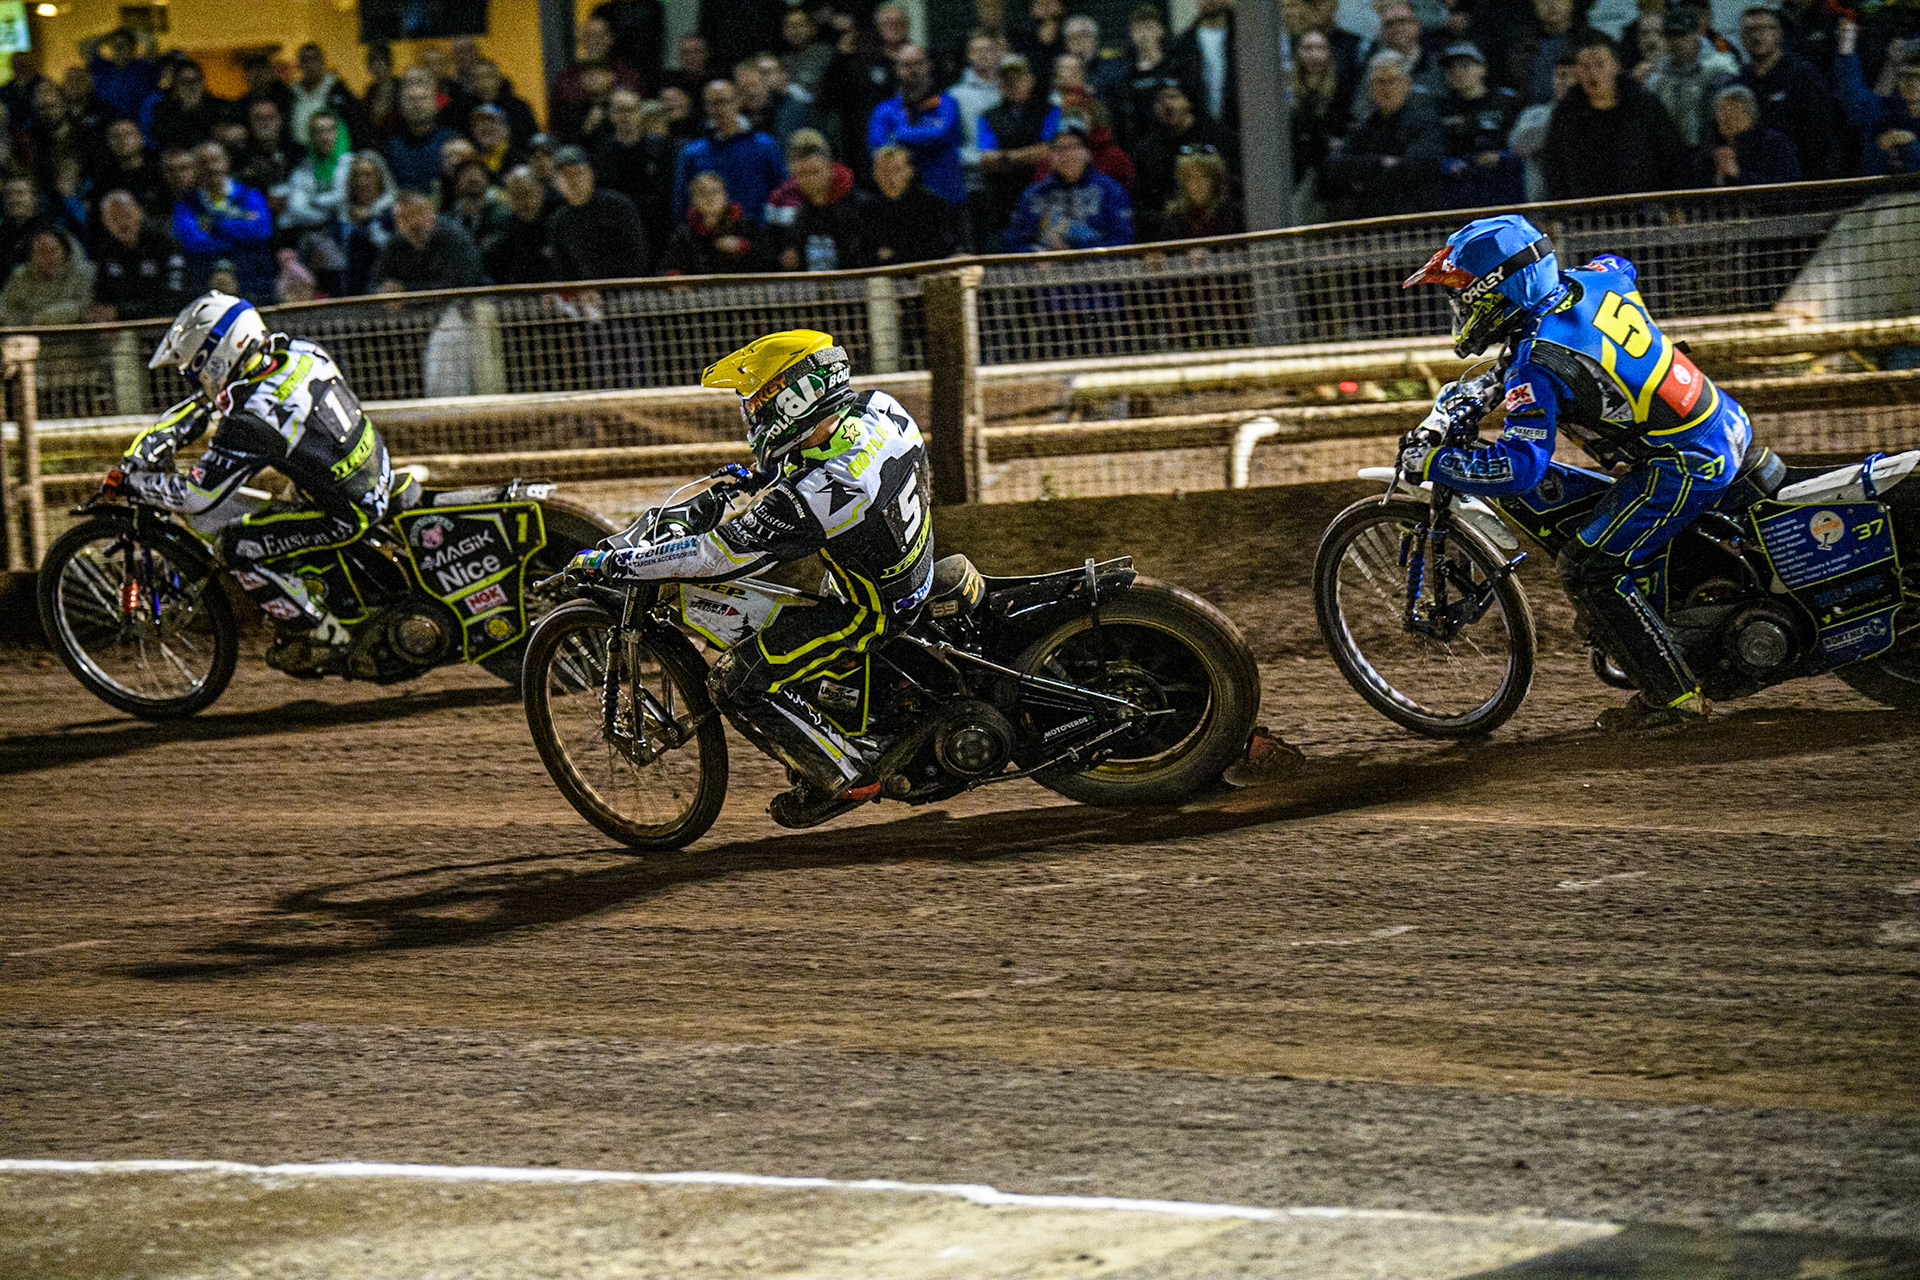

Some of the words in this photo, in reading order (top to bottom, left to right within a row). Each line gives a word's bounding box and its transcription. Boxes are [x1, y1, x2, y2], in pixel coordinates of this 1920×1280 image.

[1462, 266, 1505, 304] OAKLEY
[1592, 290, 1652, 359] 5
[323, 388, 353, 433] 1
[847, 422, 890, 479] DOYLE
[1698, 455, 1726, 481] 37
[756, 504, 795, 531] Euston
[898, 472, 921, 544] 5
[516, 512, 529, 543] 1
[1852, 518, 1885, 541] 37
[436, 554, 500, 594] Nice
[1044, 715, 1089, 739] MOTOVERDE
